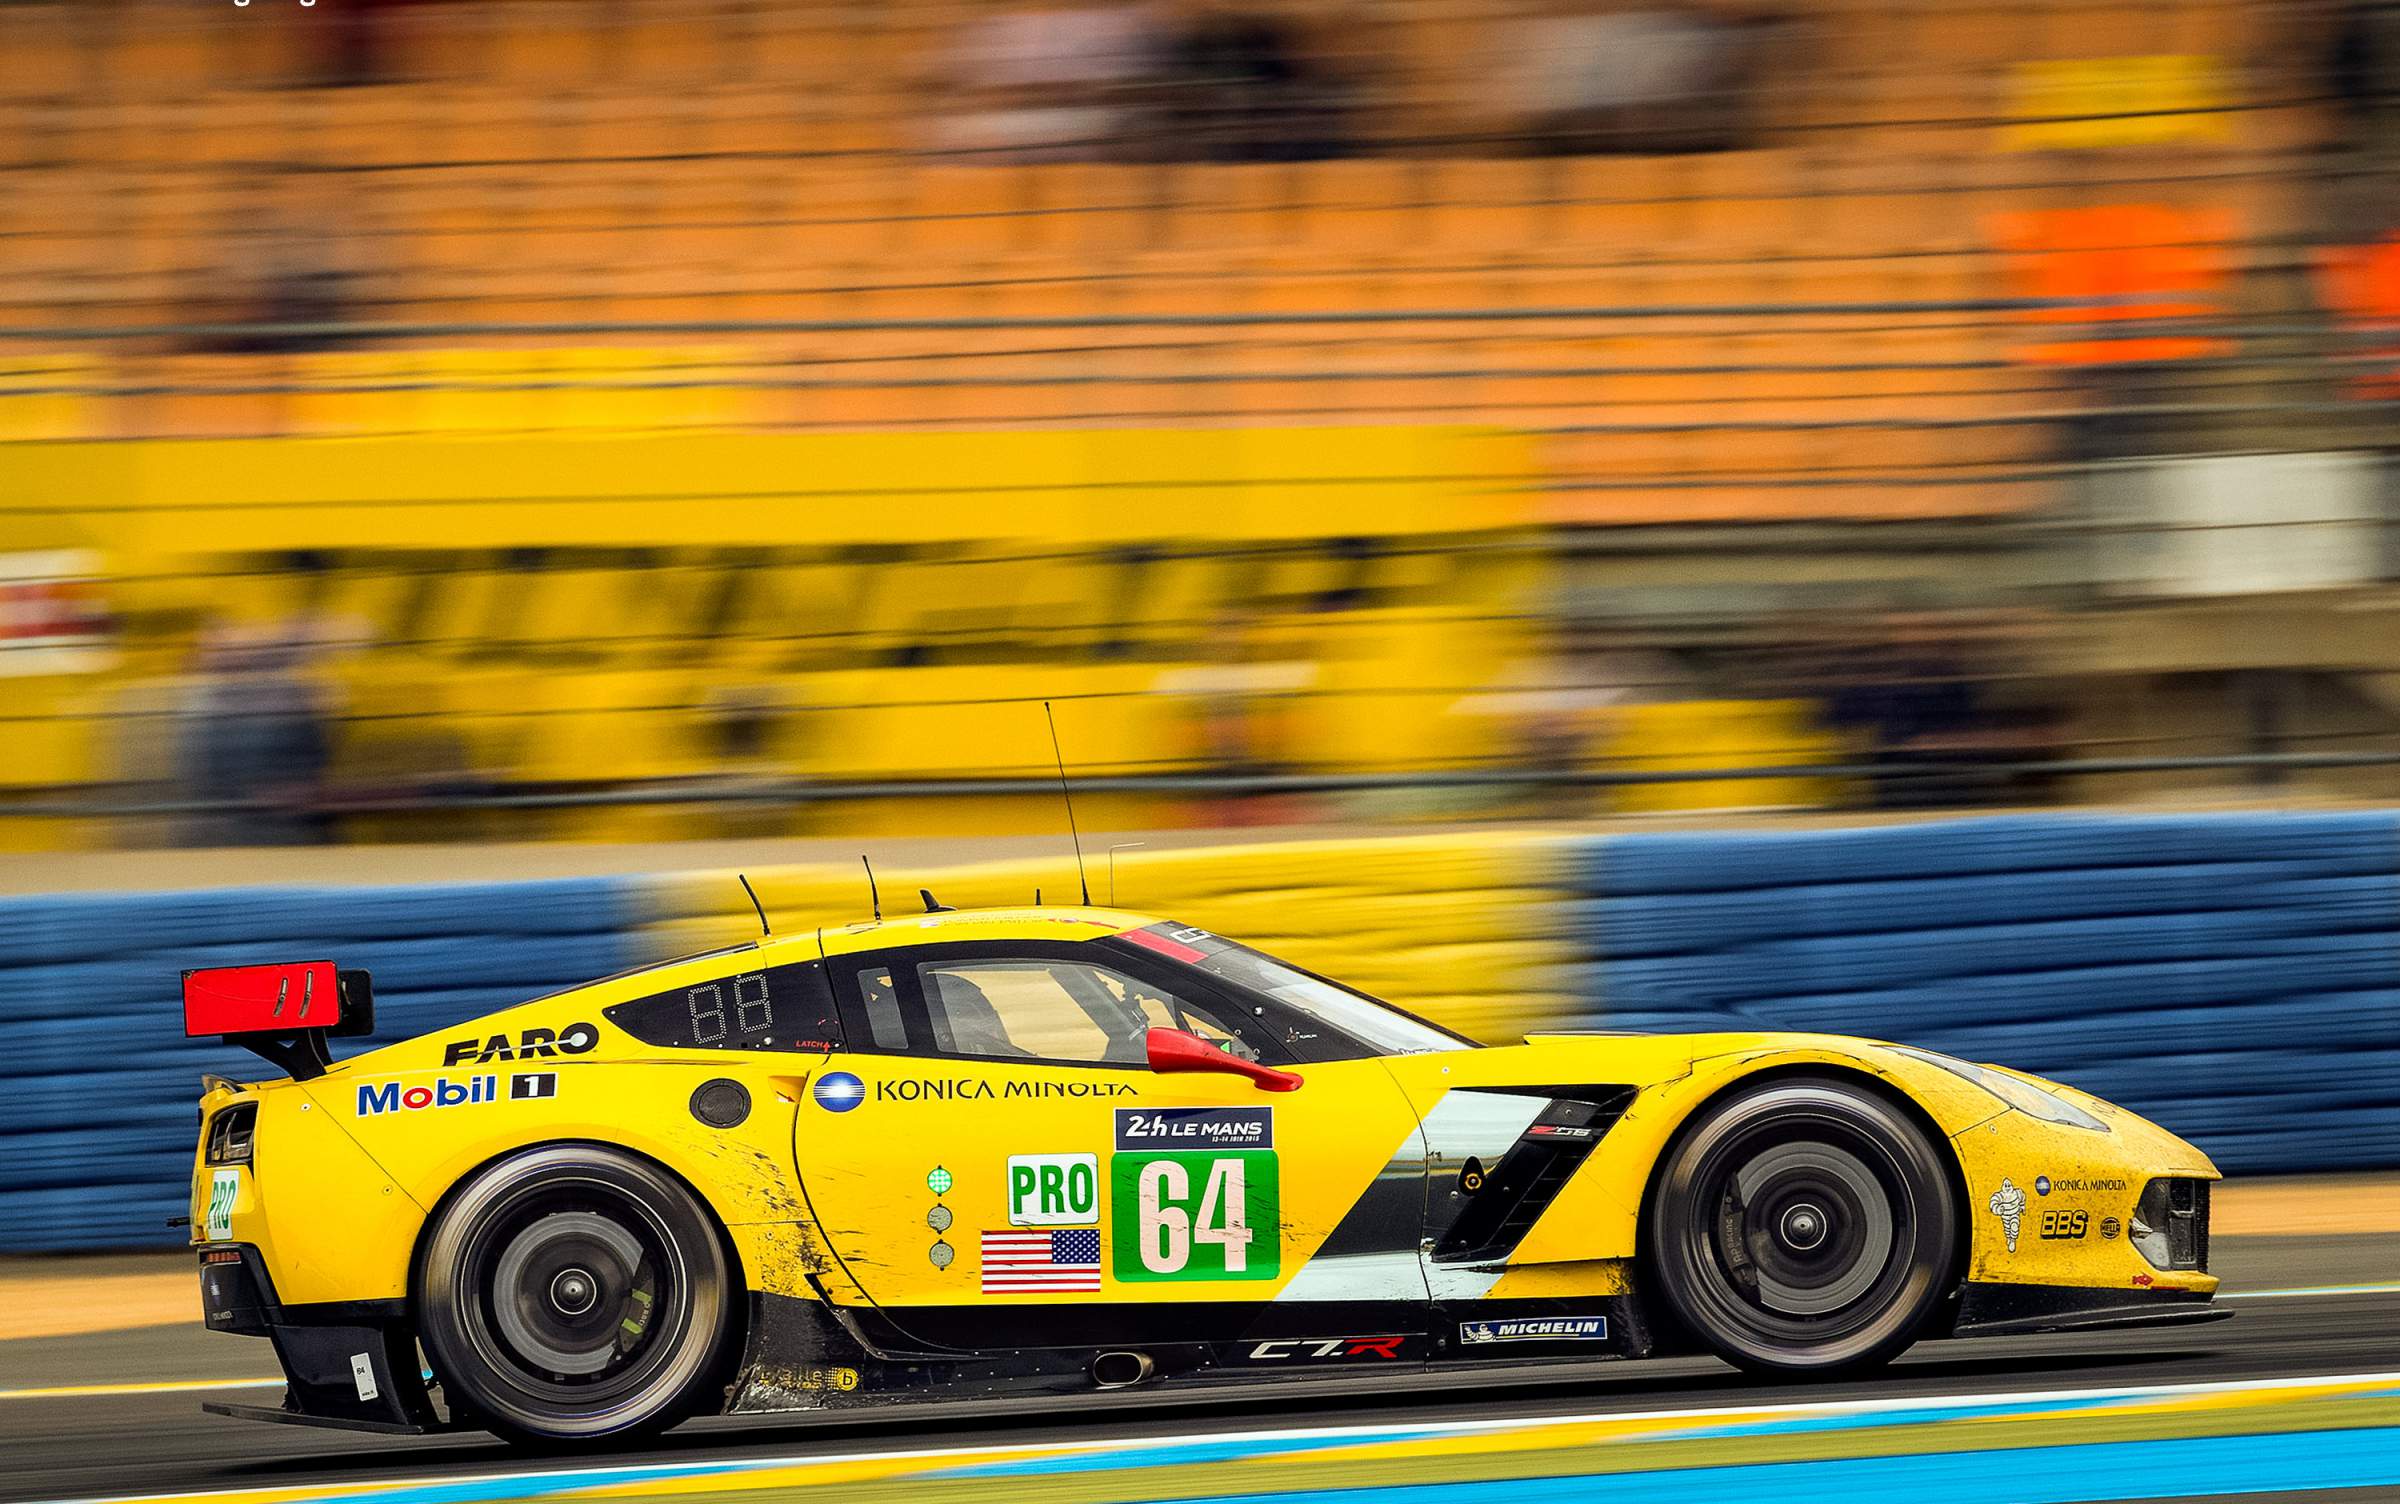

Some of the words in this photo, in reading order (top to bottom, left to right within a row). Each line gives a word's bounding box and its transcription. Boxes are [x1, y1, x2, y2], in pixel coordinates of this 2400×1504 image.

[442, 1022, 600, 1067] FARO
[796, 1040, 824, 1048] LATCH
[358, 1075, 496, 1116] Mobil
[876, 1079, 995, 1101] KONICA
[1003, 1081, 1139, 1099] MINOLTA
[1171, 1123, 1199, 1136] LE
[1201, 1122, 1262, 1136] MANS
[1012, 1163, 1094, 1215] PRO
[2053, 1179, 2088, 1191] KONICA
[2090, 1179, 2127, 1191] MINOLTA
[208, 1180, 237, 1230] PRO
[1138, 1158, 1253, 1274] 64
[2040, 1209, 2089, 1240] BBS
[1498, 1321, 1599, 1336] MICHELIN
